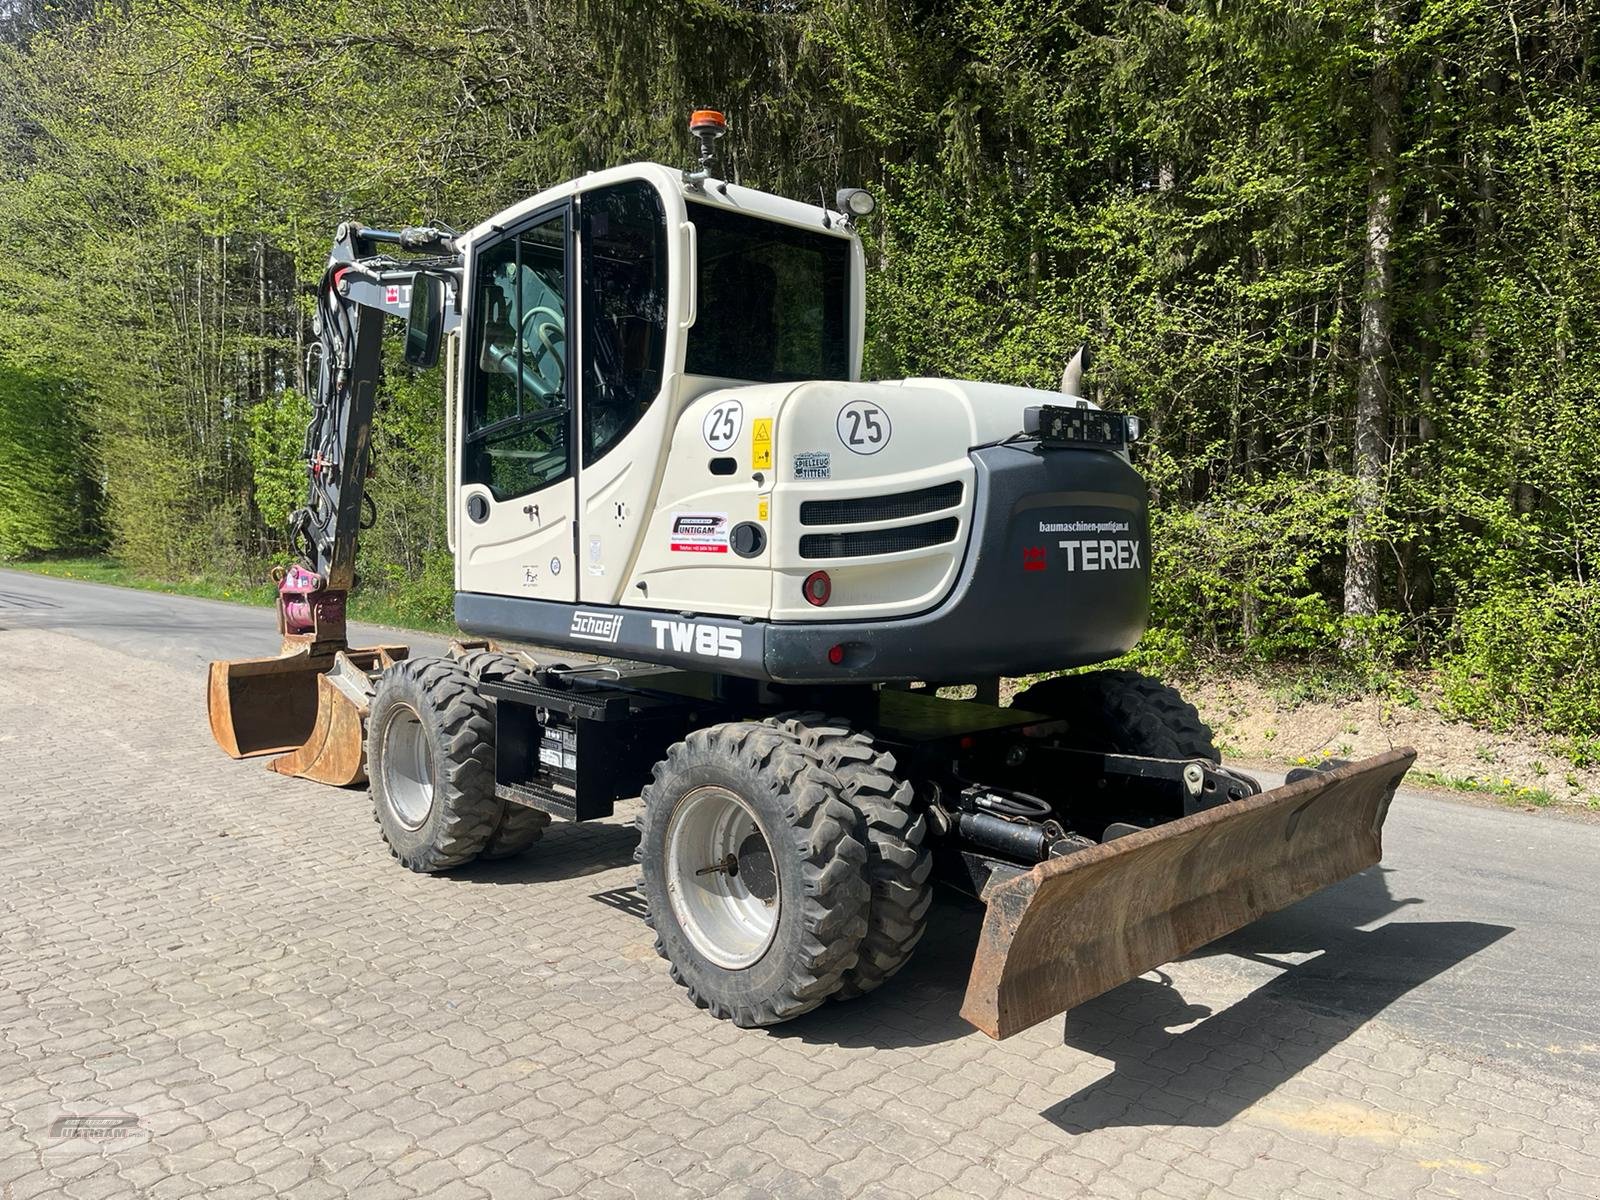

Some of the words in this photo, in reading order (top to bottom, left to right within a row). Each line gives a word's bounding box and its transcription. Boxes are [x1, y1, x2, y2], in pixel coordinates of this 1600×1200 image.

[709, 407, 739, 441] 25
[846, 409, 883, 445] 25
[795, 457, 829, 468] SPIELZEUG
[1059, 540, 1141, 571] TEREX
[569, 611, 624, 643] Schaeff
[651, 619, 742, 660] TW85
